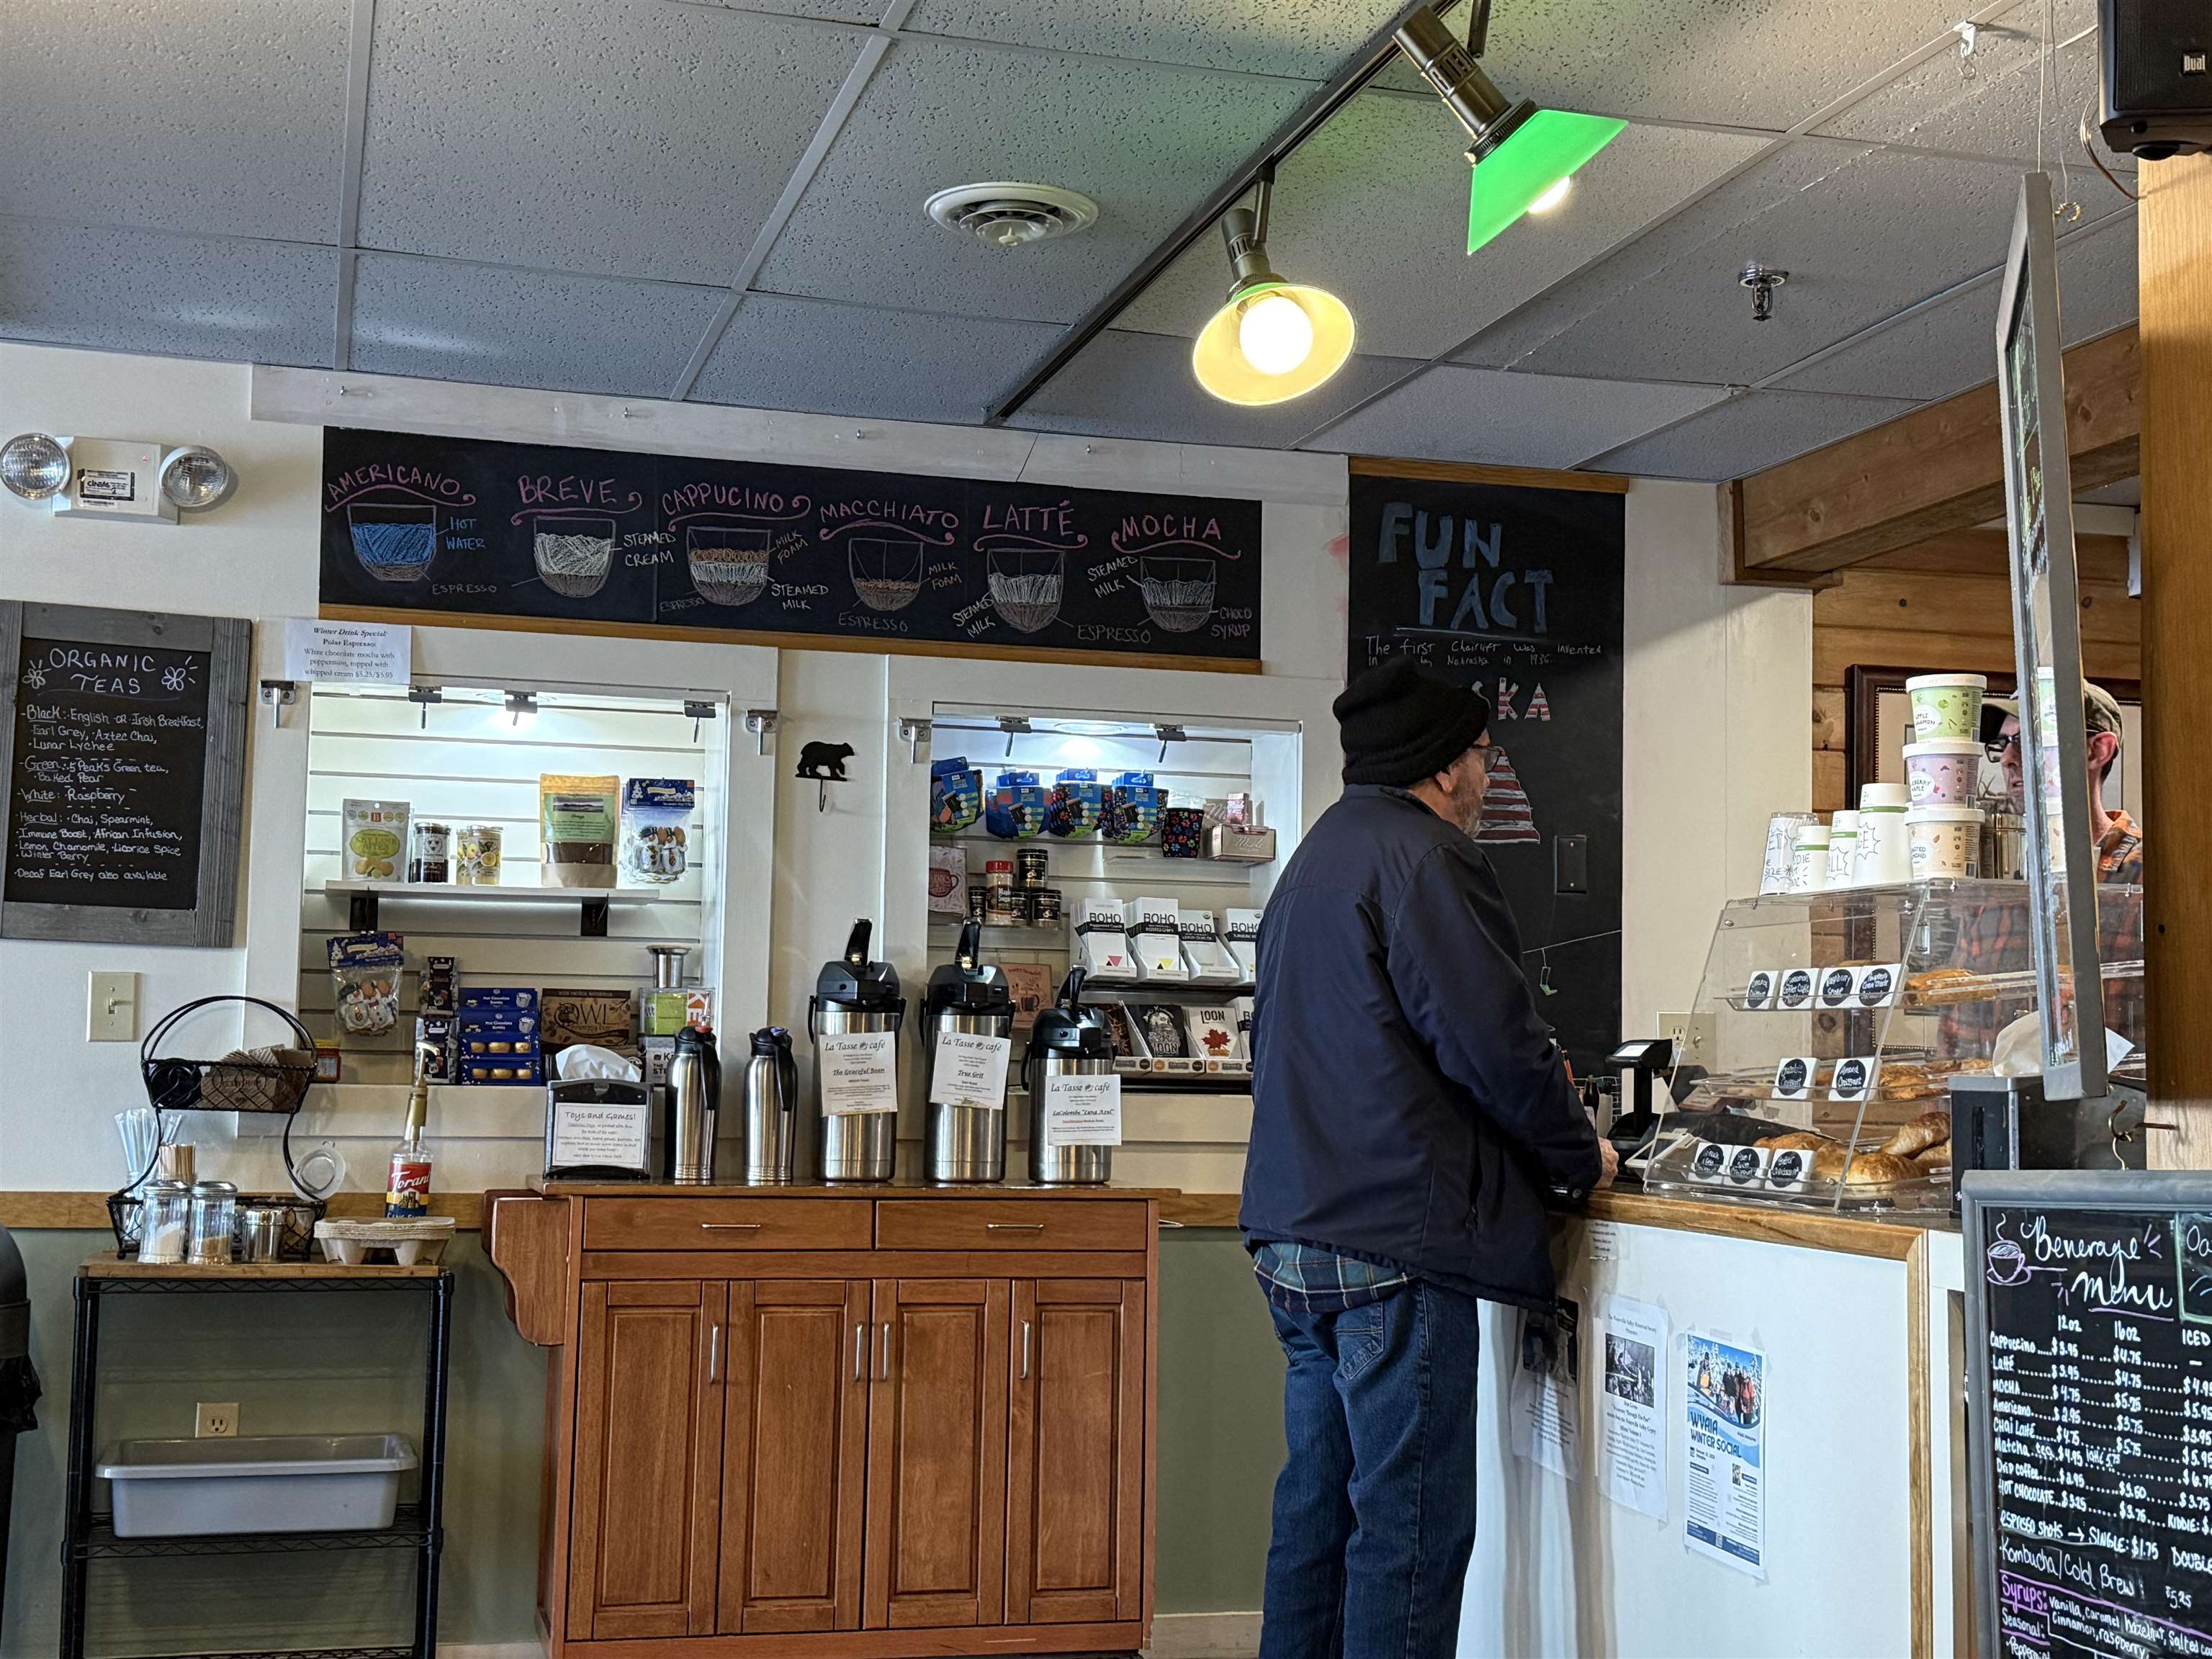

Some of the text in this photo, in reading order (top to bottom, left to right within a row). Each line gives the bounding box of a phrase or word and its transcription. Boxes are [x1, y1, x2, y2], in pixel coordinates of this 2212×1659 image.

[2184, 54, 2206, 71] Dual
[327, 464, 460, 501] AMERICANO
[518, 475, 617, 503] BREVE
[662, 483, 783, 516] CAPPUCINO
[819, 500, 959, 529] MACCHIATO
[984, 500, 1074, 536] LATTÉ
[449, 518, 476, 531] HOT
[1122, 514, 1221, 541] MOCHA
[446, 535, 485, 550] WATER
[623, 531, 676, 547] STEAMED
[775, 530, 802, 549] MILK
[1377, 502, 1502, 568] FUN
[625, 549, 675, 566] CREAM
[778, 539, 808, 564] FOAM
[929, 561, 958, 575] MILK
[1087, 556, 1138, 582] STEAMED
[432, 583, 497, 595] ESPRESSO
[771, 584, 828, 596] STEAMED
[932, 573, 962, 589] FOAM
[1094, 579, 1125, 598] MILK
[783, 600, 811, 610] MILK
[953, 595, 994, 626] STEAMED
[1417, 569, 1554, 634] FACT
[838, 612, 908, 632] ESPRESSO
[1220, 607, 1252, 619] CHOCO
[967, 616, 996, 639] MILK
[1077, 624, 1151, 644] ESPRESSO
[1211, 624, 1251, 639] SYRUP
[1365, 635, 1390, 655] The
[1400, 638, 1436, 656] first
[49, 647, 156, 672] ORGANIC
[70, 674, 140, 694] TEAS
[70, 709, 109, 728] English
[132, 713, 156, 727] Irish
[33, 724, 54, 735] Earl
[58, 726, 89, 740] Grey,
[95, 731, 127, 742] Aztec
[34, 738, 115, 751] Lunar Lychee
[113, 761, 142, 772] Green
[78, 773, 104, 783] Pear
[68, 788, 125, 805] Raspberry
[100, 814, 153, 827] Spearmint,
[19, 828, 183, 841] Immune Boost, African Infusion,
[19, 841, 52, 851] Lemon
[114, 842, 150, 853] Licorice
[154, 845, 181, 856] Spice
[58, 852, 89, 864] Berry
[17, 869, 168, 881] Decaf Earl Grey also available
[1089, 912, 1121, 925] BOHO
[1143, 913, 1175, 925] BOHO
[1180, 922, 1211, 933] BOHO
[1200, 1010, 1225, 1024] LOON
[825, 1039, 886, 1051] La Tasse café
[942, 1036, 1002, 1053] La Tasse café
[1062, 1083, 1083, 1092] Tasse
[1094, 1082, 1110, 1094] café
[565, 1111, 585, 1122] Toys
[391, 1171, 431, 1192] Torani
[2020, 1215, 2141, 1274] Beverage
[2071, 1272, 2173, 1311] Menu
[2182, 1328, 2211, 1346] ICED
[2051, 1336, 2078, 1357] $3.95
[2113, 1344, 2141, 1365] $4.75
[2051, 1364, 2080, 1380] $3.95
[2114, 1368, 2141, 1388] $4.75
[2052, 1384, 2080, 1403] $4.75
[2183, 1399, 2212, 1421] $5.95
[1691, 1411, 1719, 1436] WVAIA
[1993, 1398, 2212, 1446] Americano $2.95 $3.75 $3.95
[1691, 1429, 1715, 1449] WINTER
[1717, 1439, 1743, 1458] SOCIAL
[2056, 1425, 2080, 1446] $4.75
[2116, 1436, 2141, 1457] $5.75
[1995, 1437, 2030, 1457] Matcha
[2058, 1445, 2082, 1467] $4.95
[1996, 1457, 2211, 1511] Drip coffee $2.95 $3.75
[1998, 1478, 2014, 1496] HOT
[2014, 1483, 2055, 1505] CHOCOLATE
[2062, 1490, 2087, 1512] $3.25
[2167, 1513, 2200, 1533] KIDDIE:
[2088, 1526, 2129, 1553] SINGLE:
[2131, 1535, 2159, 1560] $1.75
[2100, 1563, 2135, 1596] Brew
[2001, 1574, 2048, 1613] Syrups:
[2002, 1607, 2046, 1638] Seasonal:
